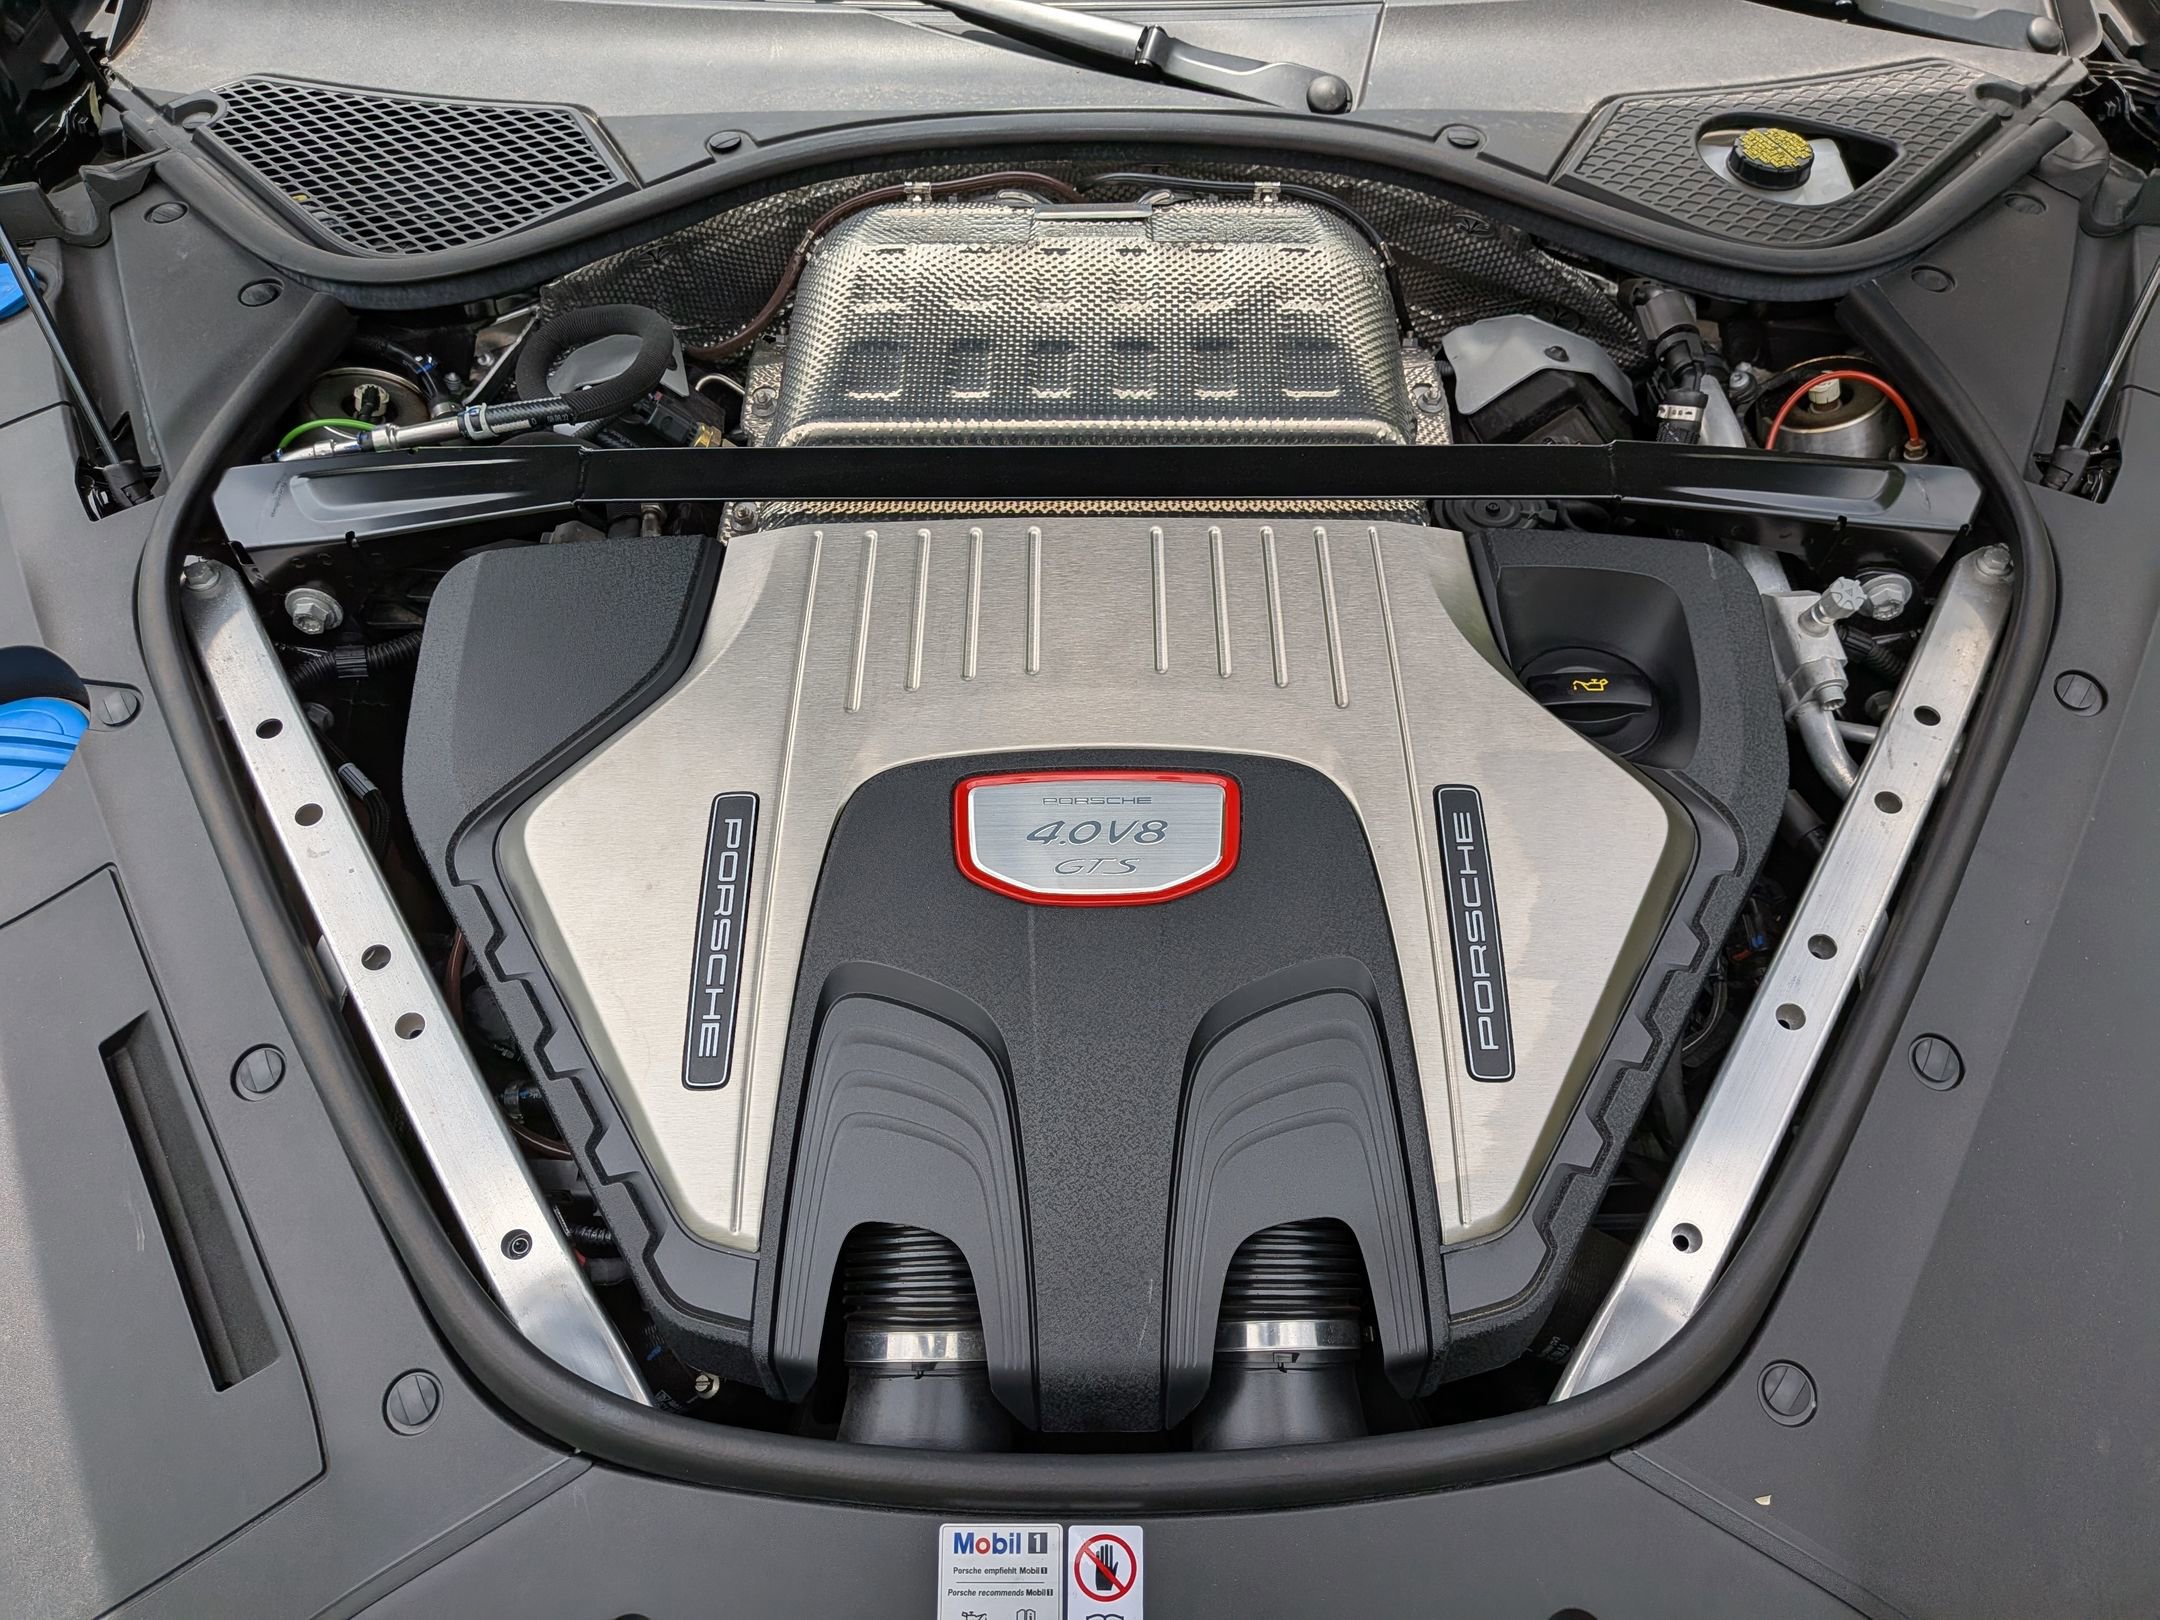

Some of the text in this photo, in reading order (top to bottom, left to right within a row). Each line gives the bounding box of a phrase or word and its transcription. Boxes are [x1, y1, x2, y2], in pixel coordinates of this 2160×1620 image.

[1043, 797, 1152, 805] PORSCHE
[1054, 858, 1140, 875] GTS
[698, 818, 742, 1058] PORSCHE
[1453, 812, 1499, 1050] PORSCHE
[953, 1532, 1021, 1555] Mobil
[953, 1566, 981, 1575] Porsche
[984, 1566, 1017, 1576] empfiehlt
[947, 1588, 976, 1597] Porsche
[978, 1588, 1025, 1597] recommends
